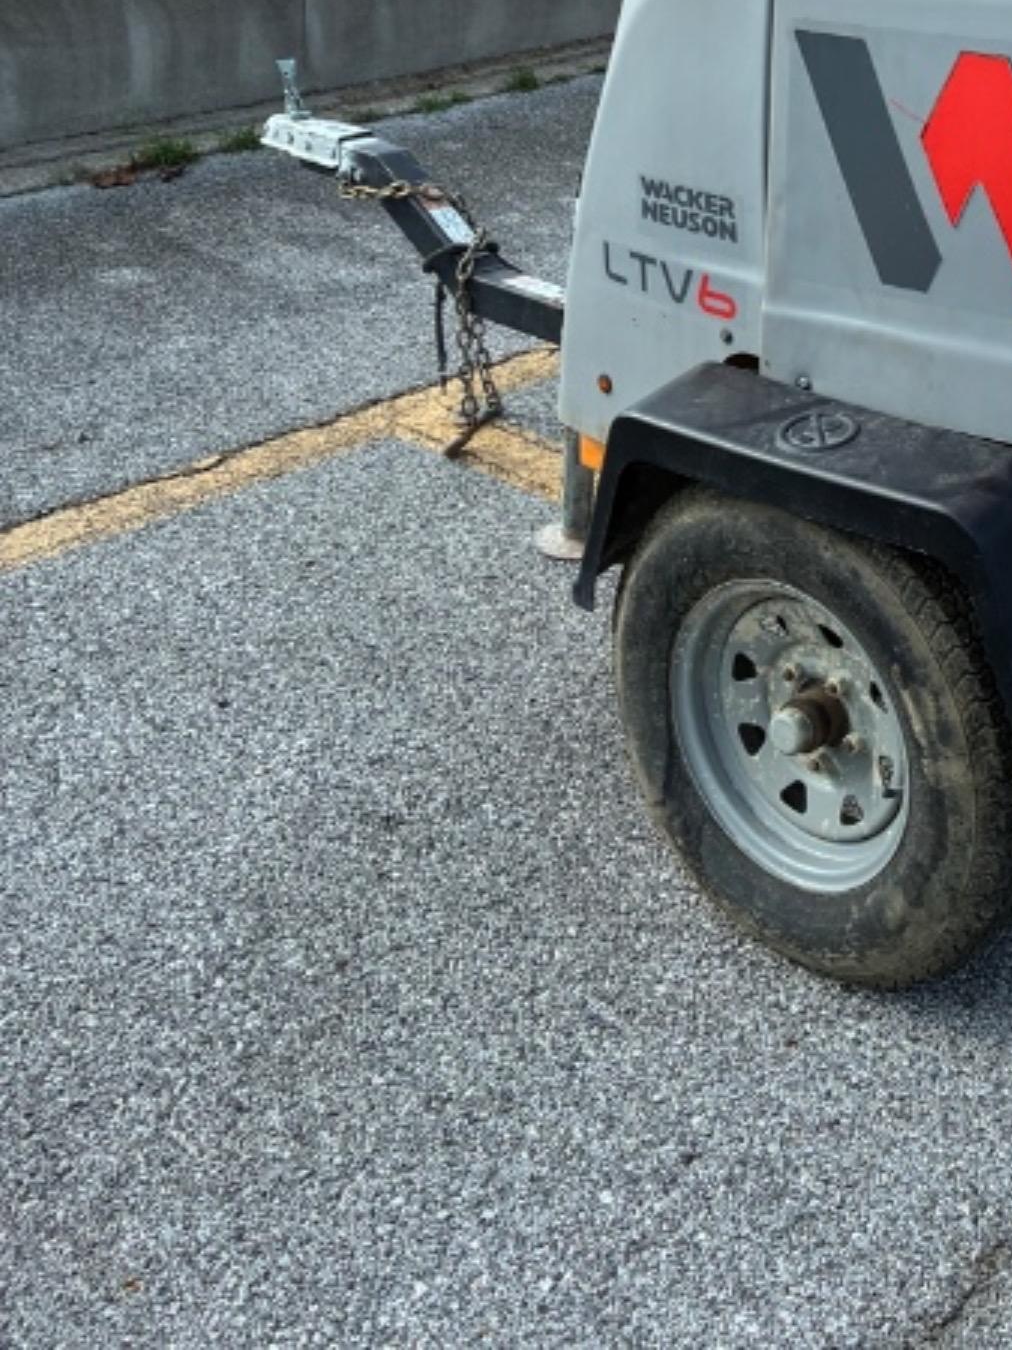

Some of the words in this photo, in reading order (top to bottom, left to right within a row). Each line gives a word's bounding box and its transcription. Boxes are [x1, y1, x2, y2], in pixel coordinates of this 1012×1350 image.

[640, 175, 736, 220] WACKER
[641, 198, 738, 244] NEUSON
[603, 240, 738, 321] LTV6
